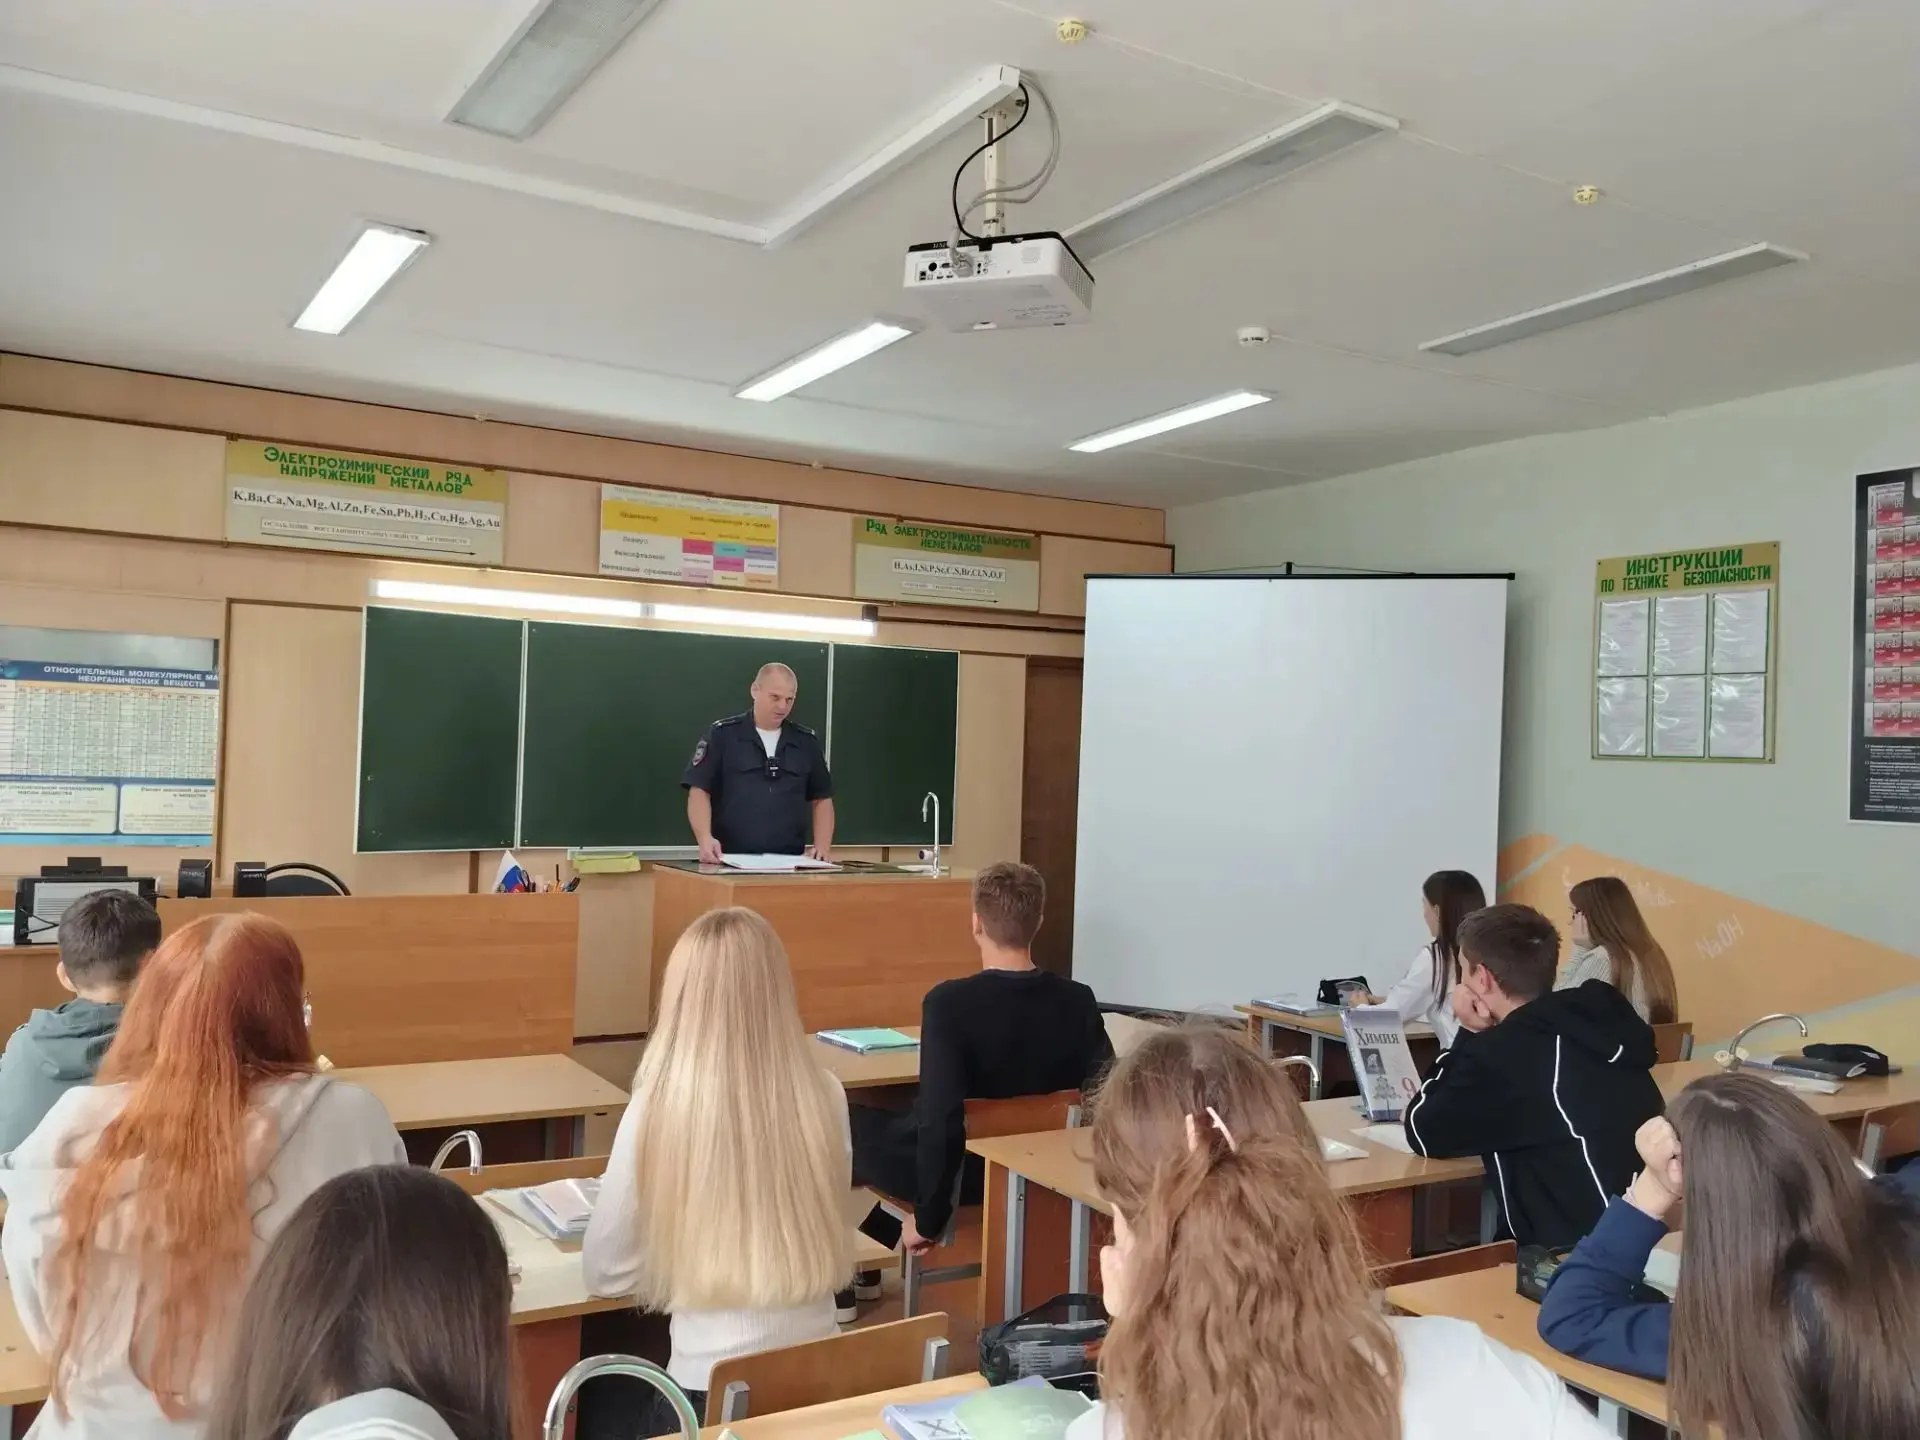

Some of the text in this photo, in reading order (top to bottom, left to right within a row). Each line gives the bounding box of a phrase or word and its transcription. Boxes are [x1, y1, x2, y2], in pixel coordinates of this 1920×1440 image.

[390, 477, 463, 494] МЕТАЛЛОВ
[445, 471, 473, 487] РЯД
[1626, 549, 1743, 576] ИНСТРУКЦИИ
[1601, 565, 1772, 593] ПО ТЕХНИКЕ БЕЗОПАСНОСТИ
[44, 665, 219, 682] ОТНОСИТЕЛЬНЫЕ МОЛЕКУЛЯРНЫЕ МА
[78, 675, 206, 688] НЕОРГАНИЧЕСКИХ ВЕЩЕСТВ
[1695, 913, 1745, 961] NaOH
[1402, 1076, 1418, 1100] 9
